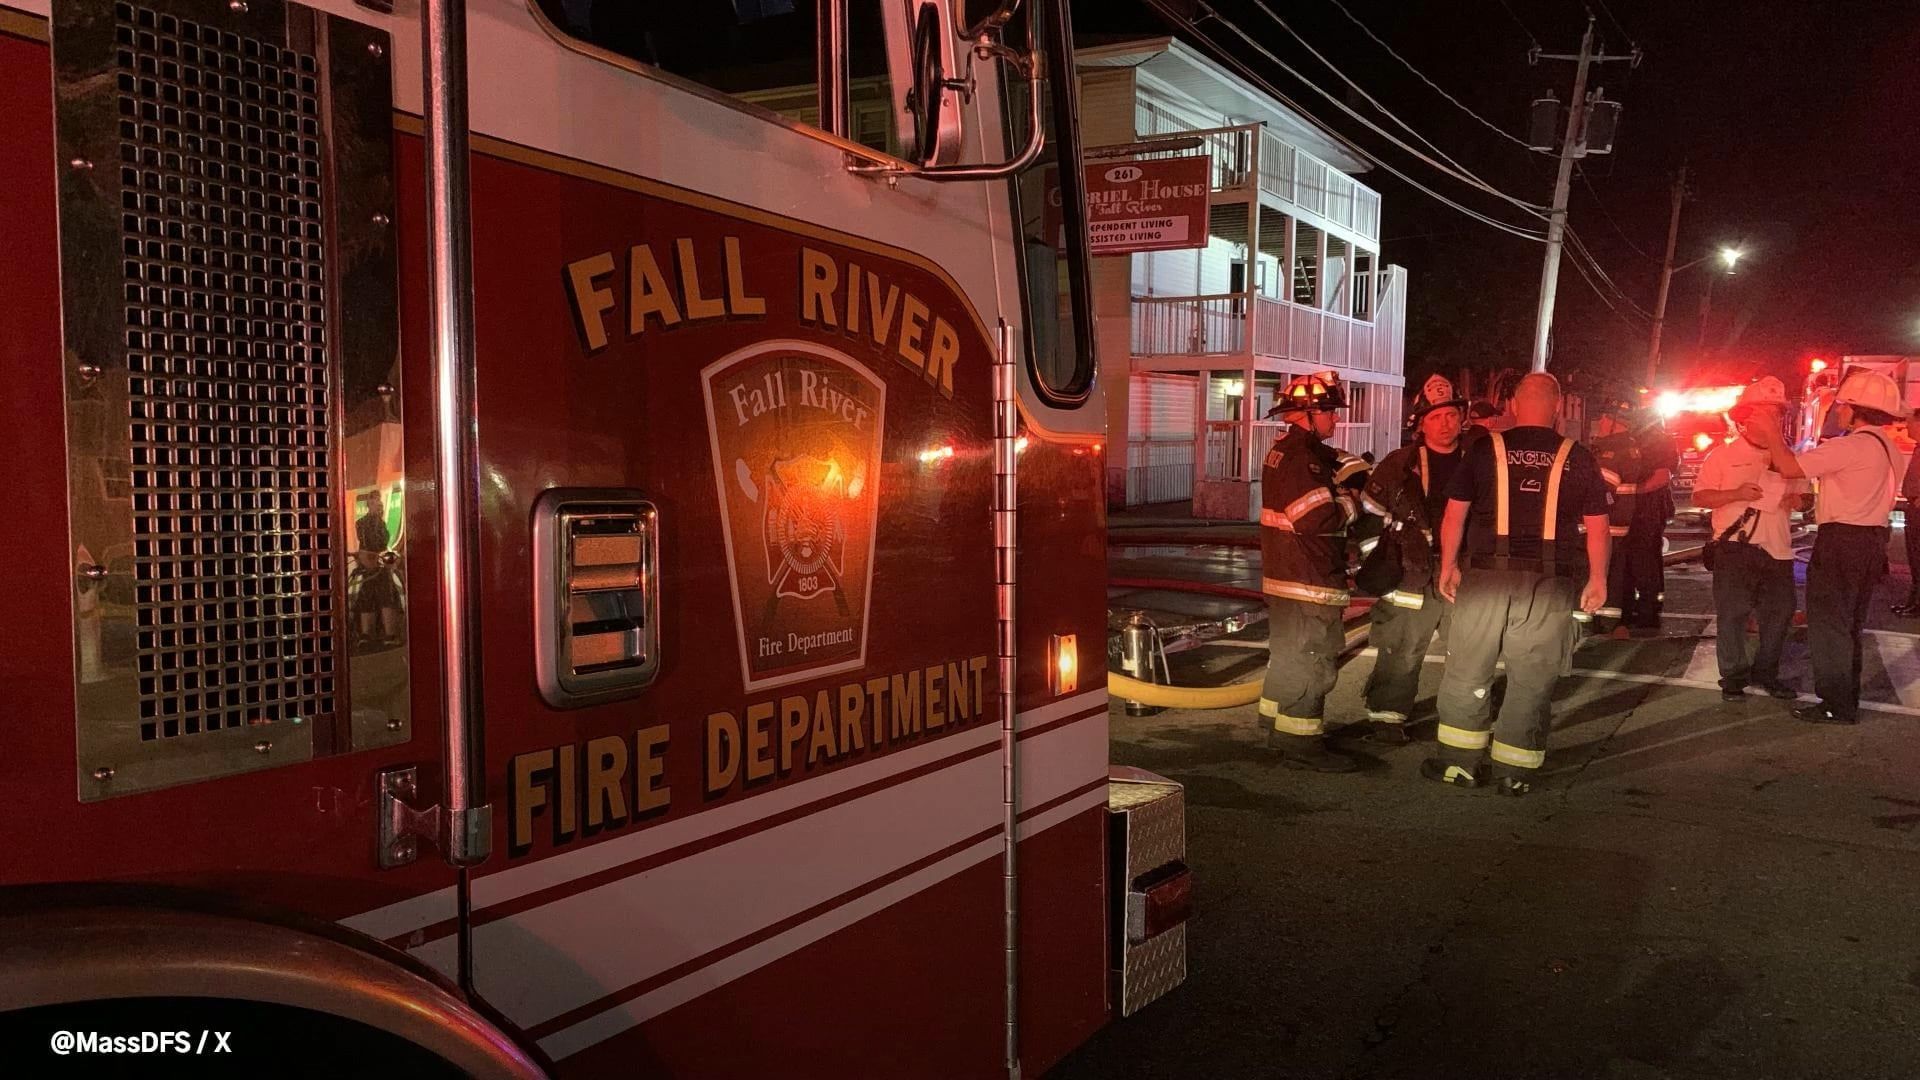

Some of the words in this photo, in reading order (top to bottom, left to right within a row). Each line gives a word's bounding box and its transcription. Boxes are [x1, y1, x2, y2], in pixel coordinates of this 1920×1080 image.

[1114, 169, 1134, 180] 261
[1089, 222, 1137, 233] EPENDENT
[1140, 219, 1173, 230] LIVING
[1089, 233, 1126, 244] SSISTED
[1129, 231, 1162, 242] LIVING
[564, 236, 766, 354] FALL
[800, 246, 960, 397] RIVER
[728, 370, 787, 427] Fall
[799, 370, 868, 431] River
[798, 575, 819, 592] 1803
[758, 637, 783, 657] Fire
[787, 627, 853, 655] Department
[510, 724, 672, 853] FIRE
[703, 656, 988, 797] DEPARTMENT
